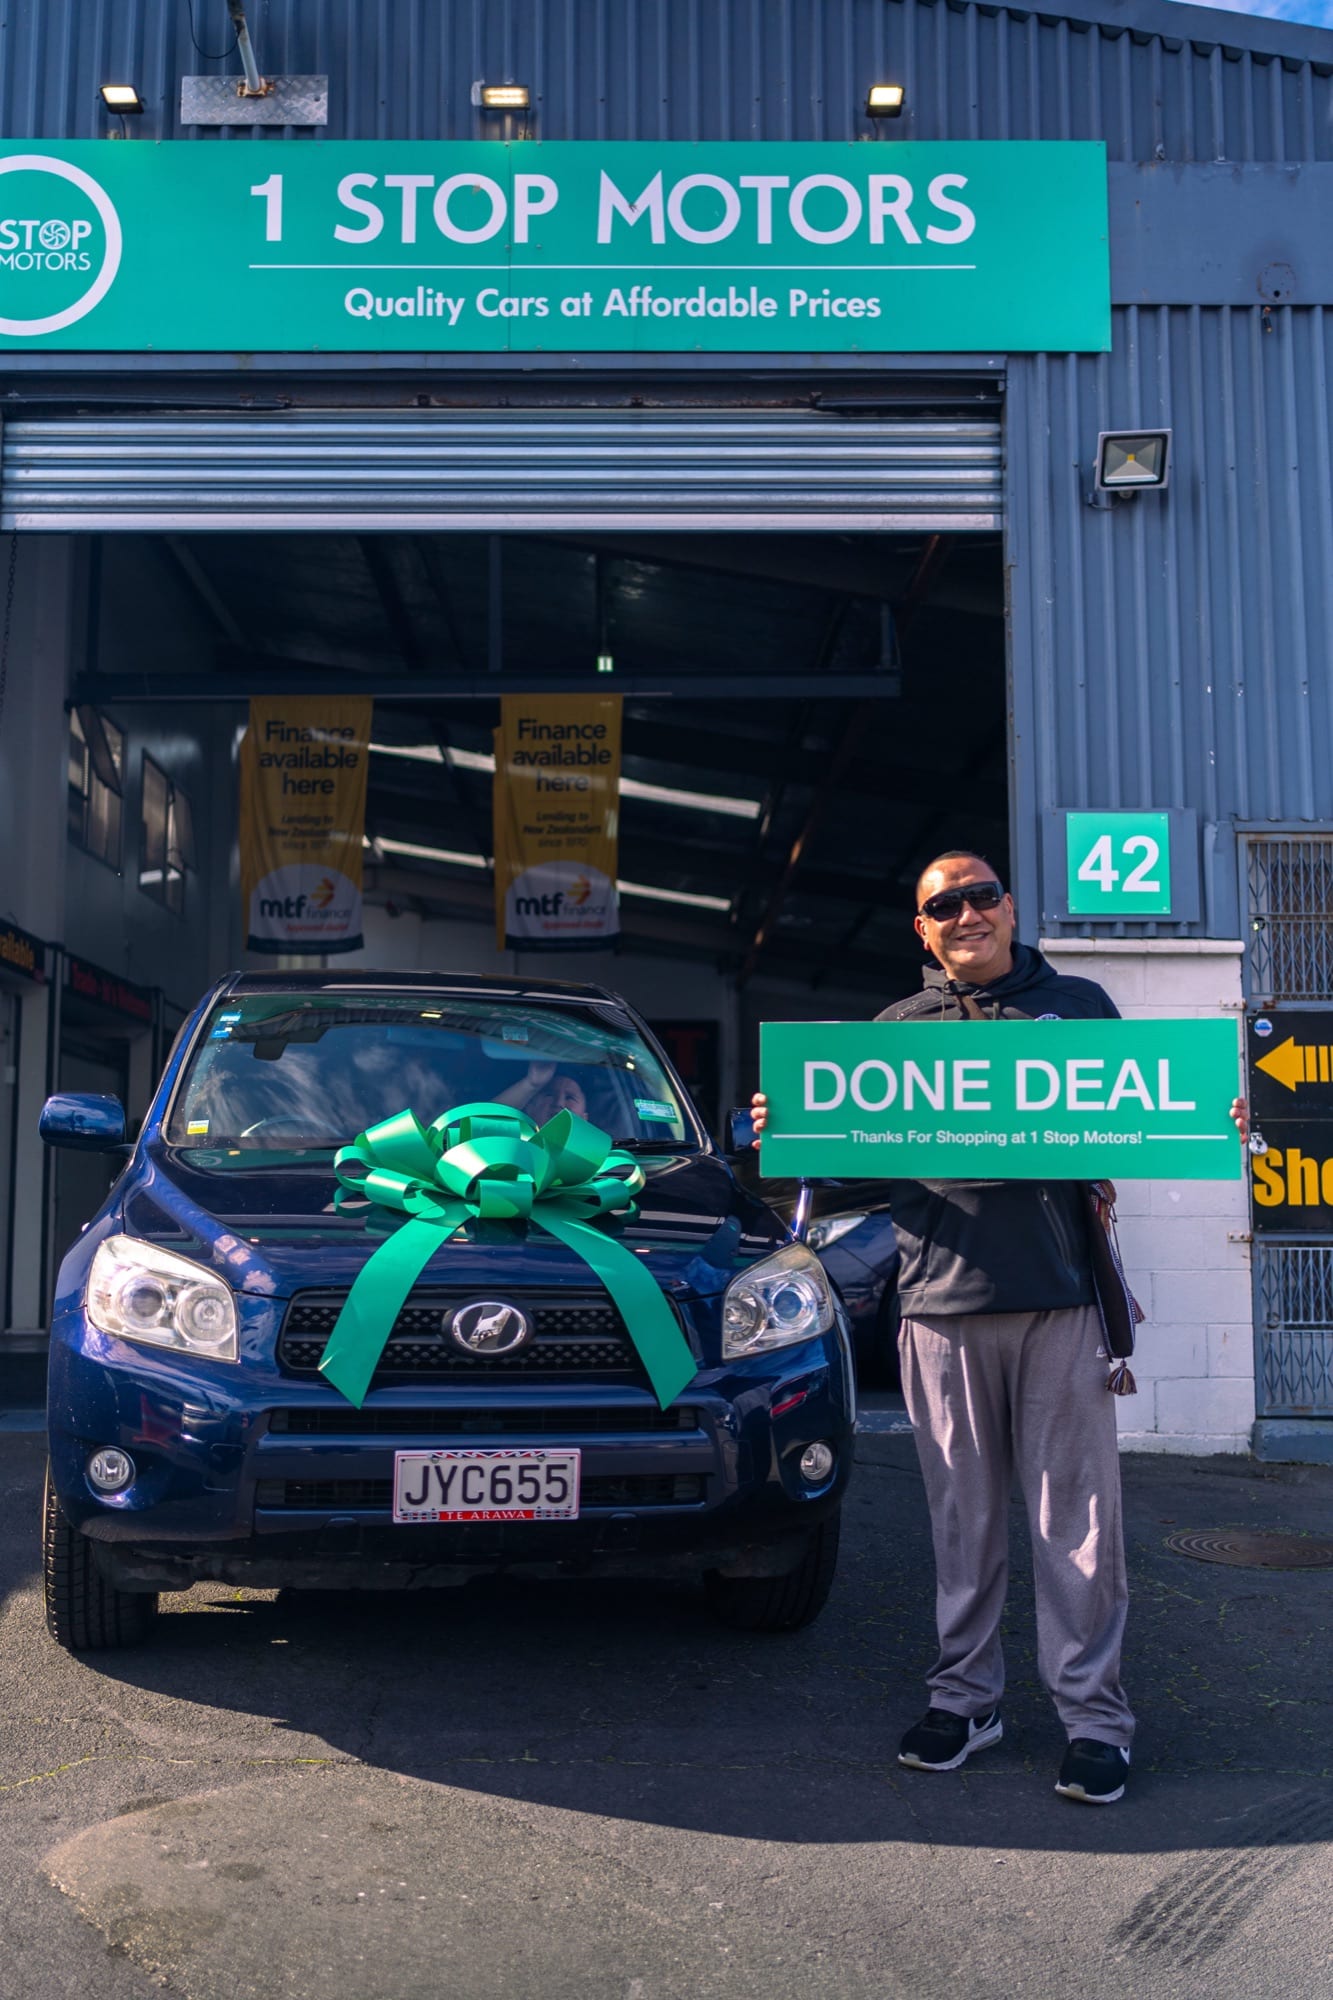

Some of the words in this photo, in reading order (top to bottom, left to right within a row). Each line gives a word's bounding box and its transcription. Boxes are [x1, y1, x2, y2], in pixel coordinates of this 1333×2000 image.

[249, 174, 284, 242] 1
[333, 173, 559, 244] STOP
[596, 169, 977, 245] MOTORS
[0, 219, 93, 250] STOP
[0, 252, 92, 271] MOTORS
[344, 286, 464, 326] Quality
[476, 287, 549, 318] Cars
[560, 289, 593, 318] at
[602, 285, 778, 319] Affordable
[789, 288, 881, 319] Prices
[265, 720, 355, 743] Finance
[517, 718, 607, 741] Finance
[259, 746, 359, 769] available
[512, 743, 612, 767] available
[282, 772, 335, 796] here
[536, 770, 589, 793] here
[1078, 835, 1161, 892] 42
[259, 894, 307, 919] mtf
[306, 907, 352, 919] finance
[516, 891, 563, 916] mtf
[803, 1059, 991, 1112] DONE
[1015, 1058, 1196, 1112] DEAL
[850, 1130, 903, 1144] Thanks
[907, 1130, 932, 1144] For
[936, 1130, 1008, 1147] Shopping
[1011, 1131, 1026, 1144] at
[1030, 1130, 1038, 1144] 1
[1043, 1130, 1080, 1146] Stop
[1083, 1130, 1143, 1145] Motors!
[404, 1464, 568, 1506] JYC655
[446, 1511, 464, 1520] TE
[472, 1510, 527, 1520] ARAWA
